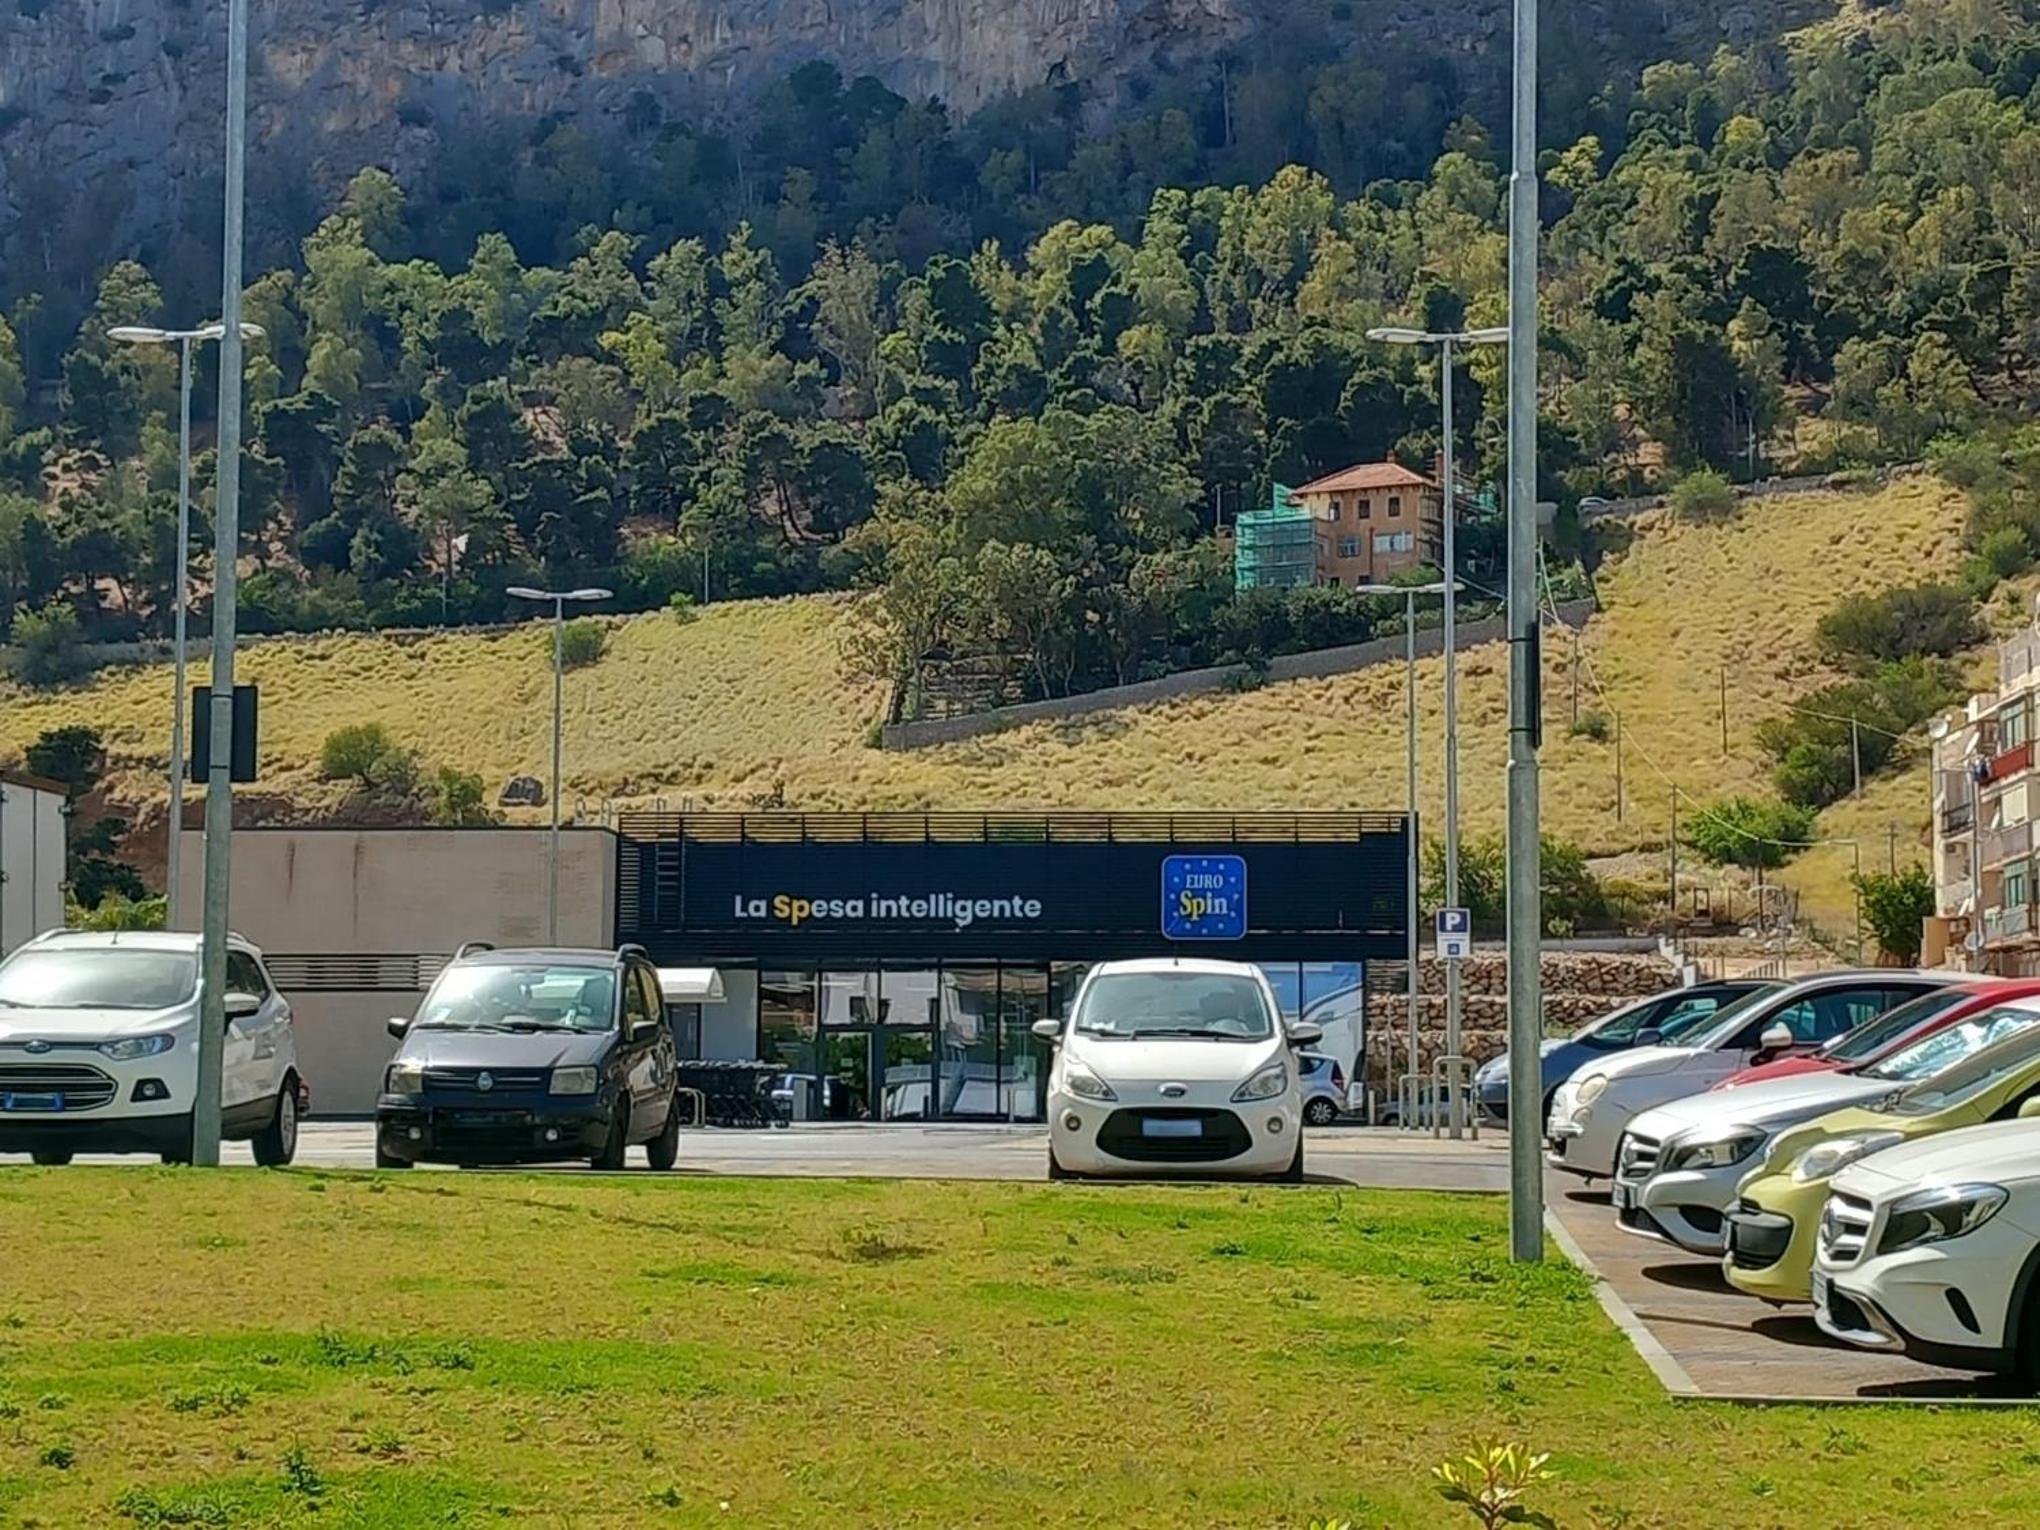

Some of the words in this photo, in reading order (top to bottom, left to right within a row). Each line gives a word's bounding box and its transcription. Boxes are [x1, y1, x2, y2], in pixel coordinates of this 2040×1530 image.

[1186, 874, 1224, 889] EURO
[735, 895, 766, 918] La
[773, 894, 864, 925] Spesa
[871, 892, 1042, 928] intelligente
[1180, 890, 1228, 921] Spin
[1445, 912, 1460, 931] P
